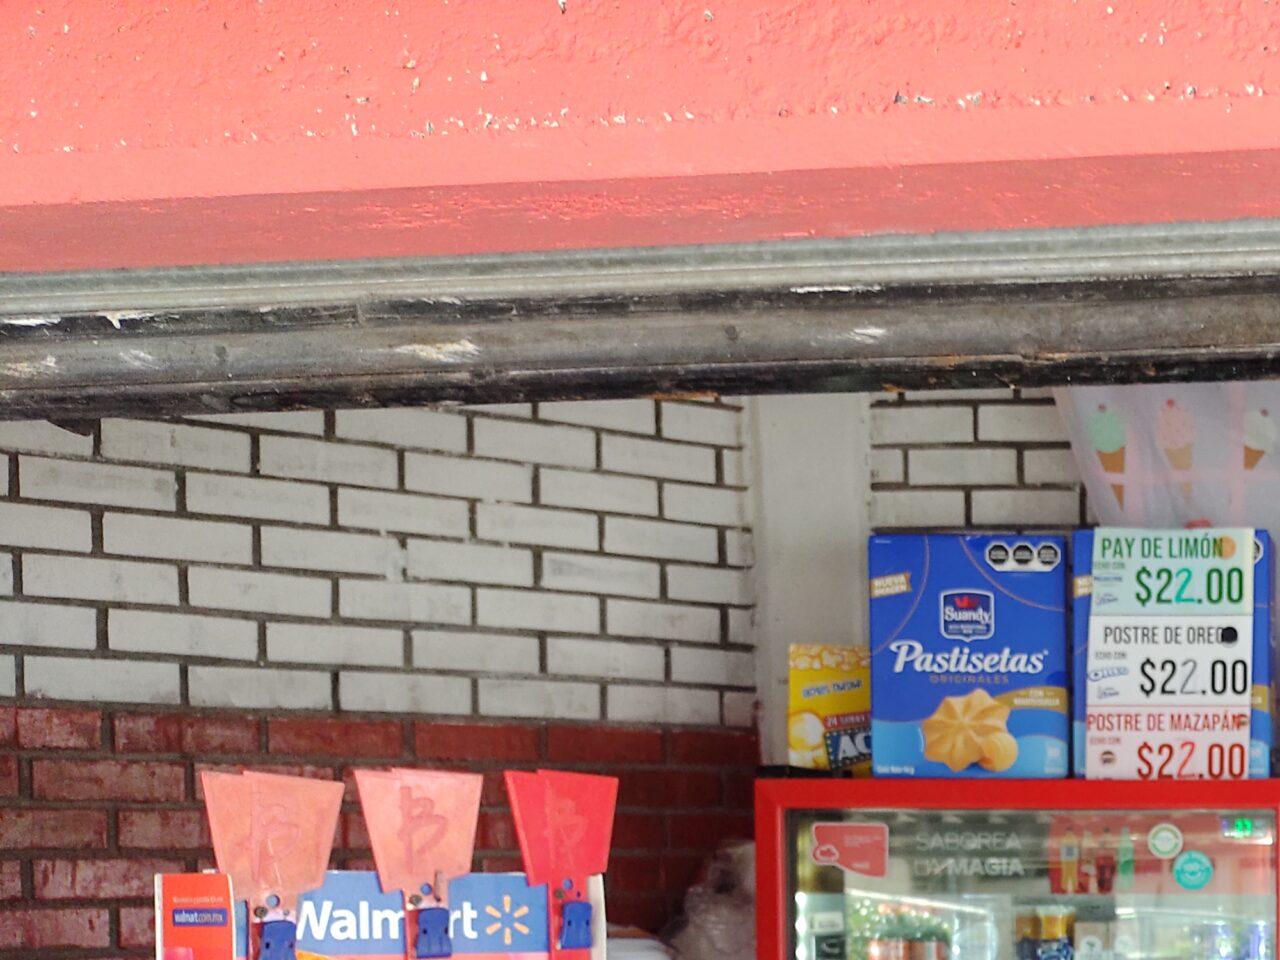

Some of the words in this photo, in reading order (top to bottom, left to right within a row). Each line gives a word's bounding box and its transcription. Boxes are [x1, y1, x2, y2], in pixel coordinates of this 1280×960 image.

[1102, 538, 1135, 559] PAY
[1142, 538, 1162, 559] DE
[1169, 533, 1224, 559] LIMÓN
[1135, 566, 1244, 606] $22.00
[944, 606, 992, 624] Suandy
[1104, 626, 1160, 644] POSTRE
[1164, 626, 1183, 644] DE
[890, 640, 1044, 673] Pastisetas
[929, 675, 1009, 685] ORIGINALES
[1140, 659, 1248, 697] $22.00
[1087, 714, 1141, 731] POSTRE
[1147, 714, 1165, 731] DE
[1170, 711, 1241, 731] MAZAPÁN
[1137, 742, 1245, 779] $22.00
[915, 831, 1023, 850] SABOREA
[951, 857, 1025, 876] MAGIA
[296, 901, 478, 940] Walmrt
